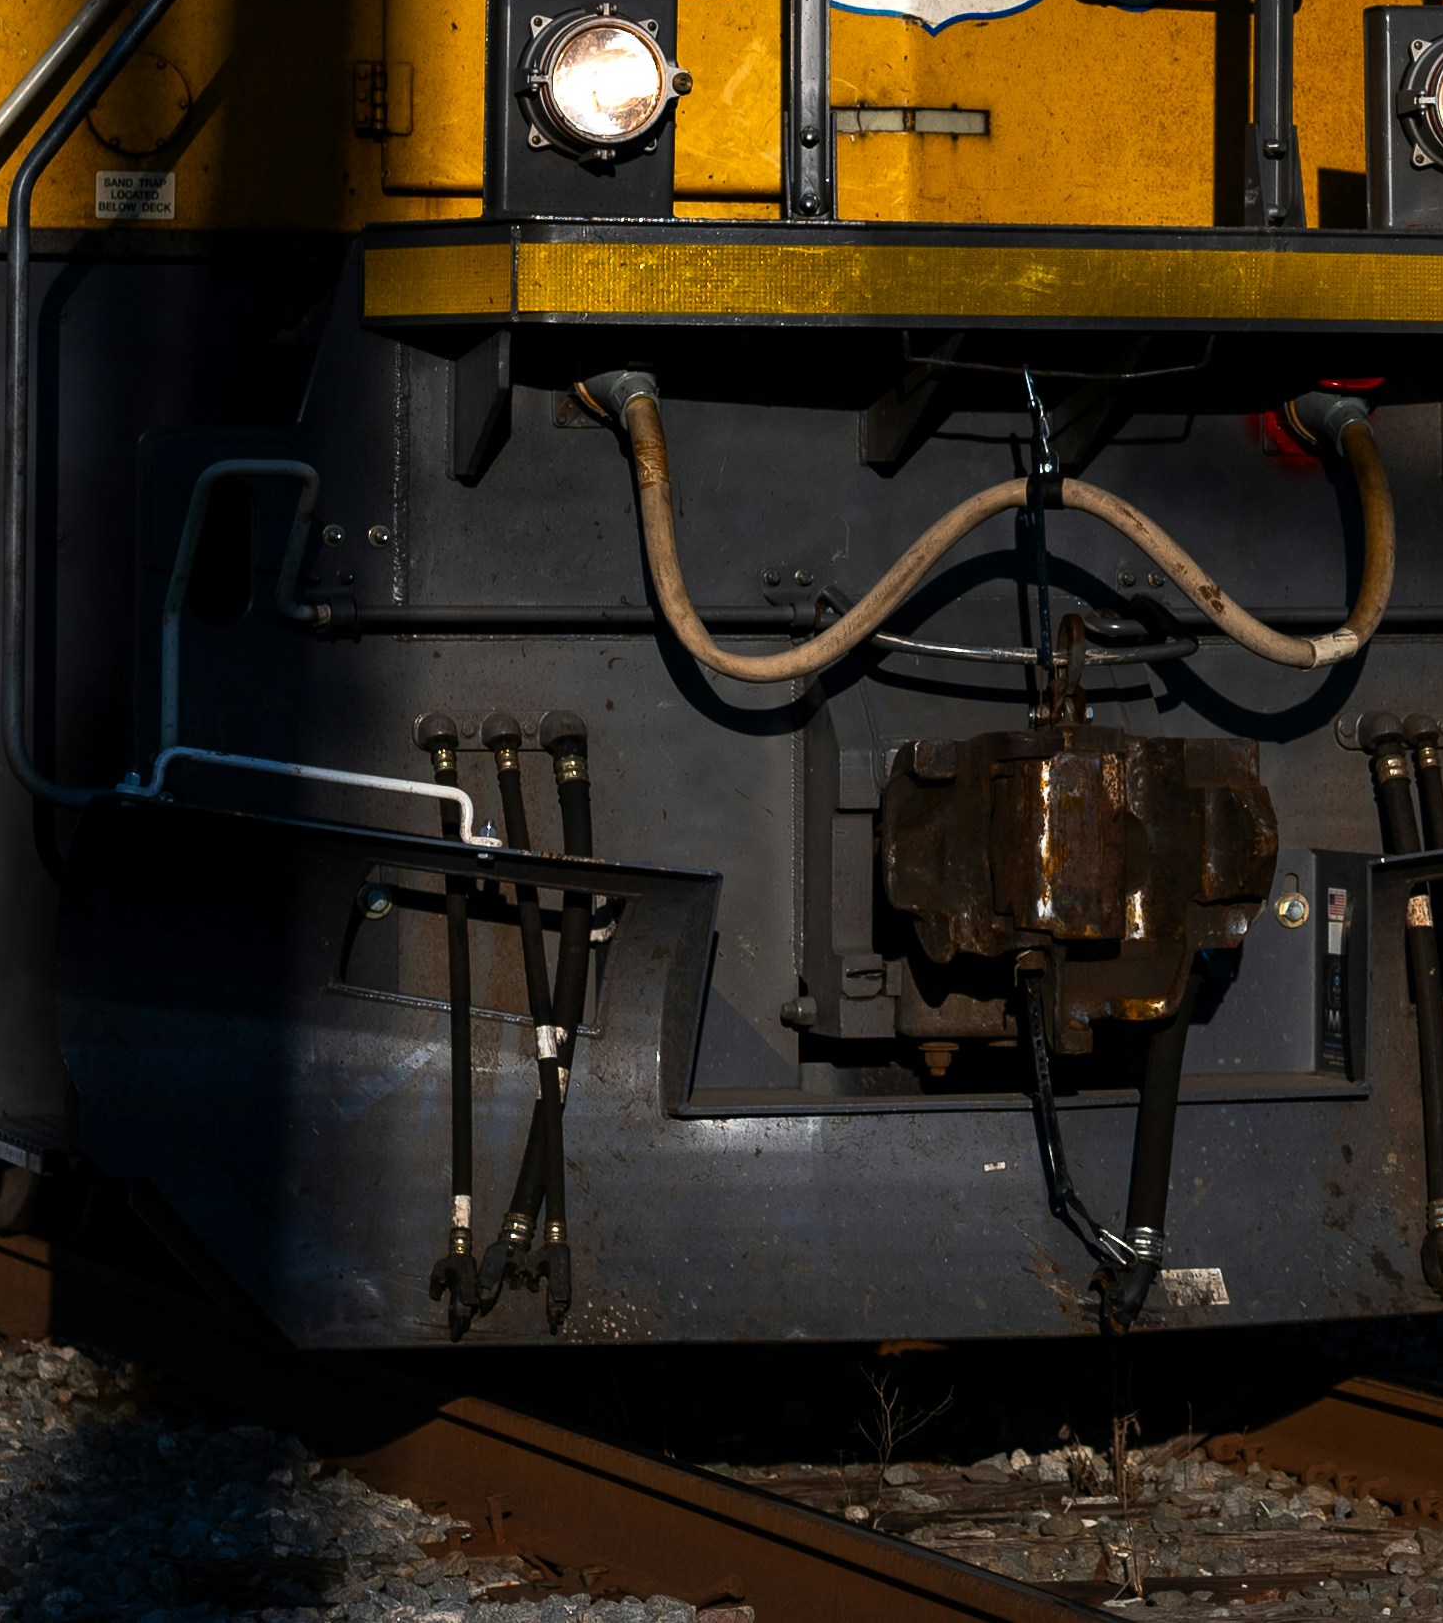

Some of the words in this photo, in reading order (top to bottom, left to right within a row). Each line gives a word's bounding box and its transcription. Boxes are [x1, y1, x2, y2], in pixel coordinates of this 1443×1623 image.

[104, 178, 133, 188] SAND
[139, 178, 167, 188] TRAP
[111, 190, 159, 200] LOCATED
[98, 202, 136, 212] BELOW
[142, 203, 171, 212] DECK
